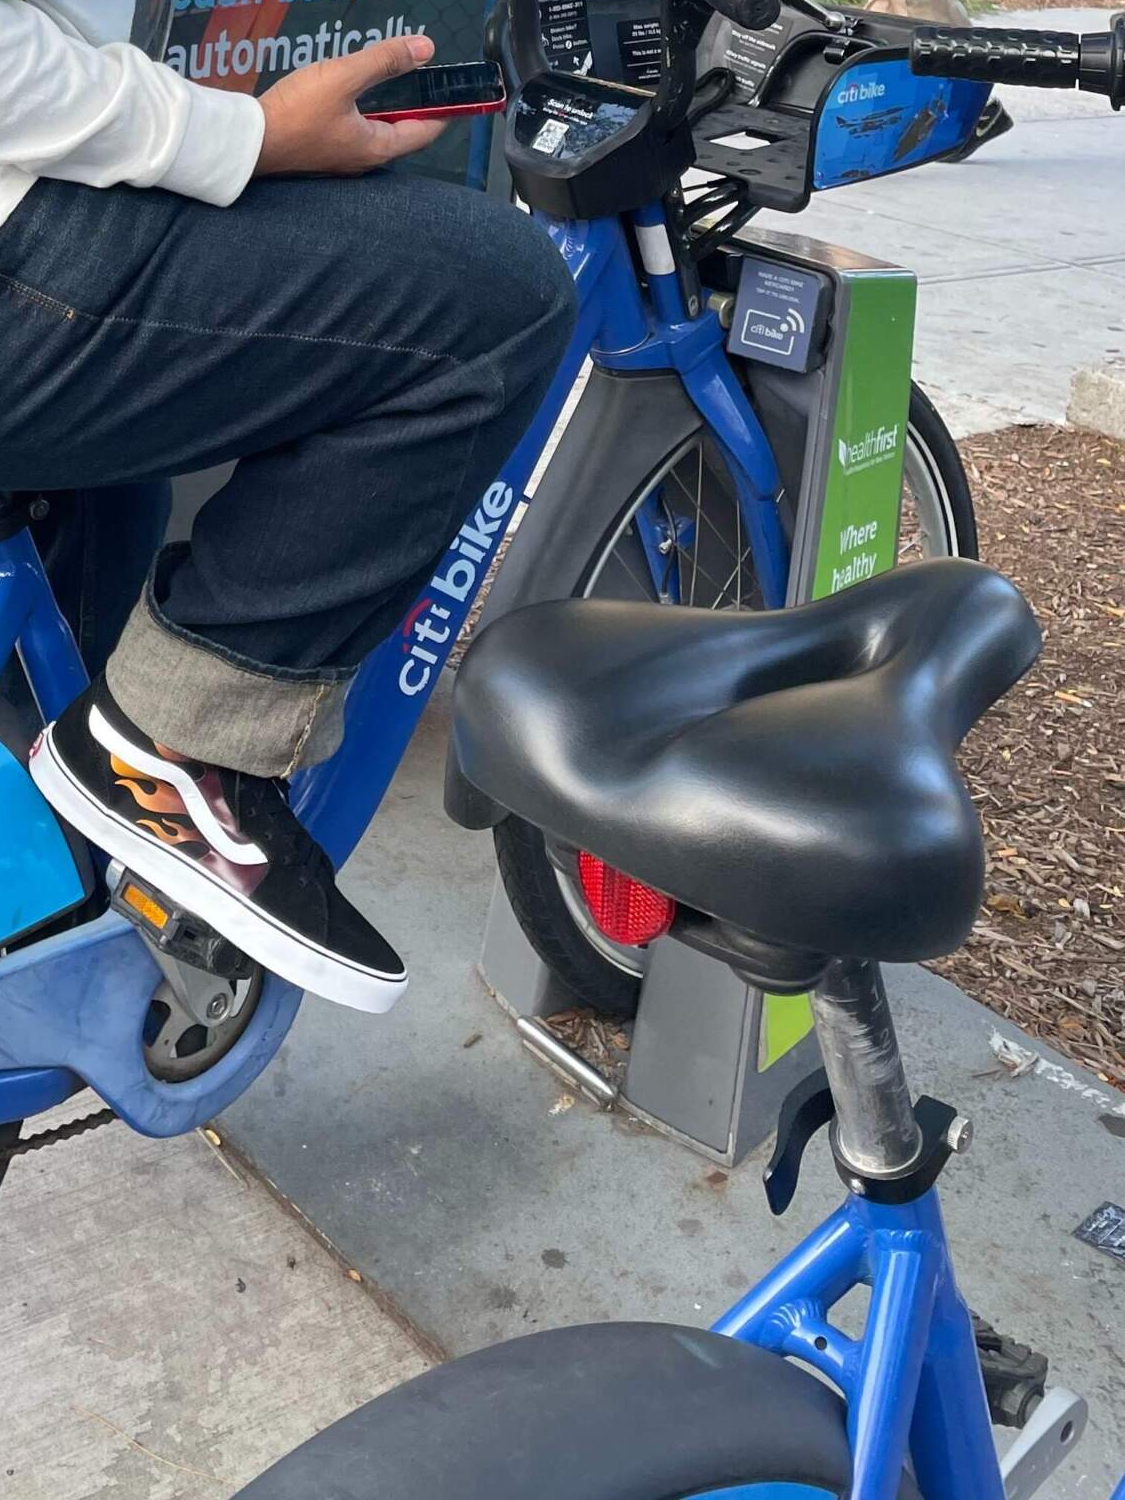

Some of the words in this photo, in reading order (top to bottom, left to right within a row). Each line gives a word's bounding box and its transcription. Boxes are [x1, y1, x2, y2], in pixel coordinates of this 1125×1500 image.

[836, 83, 858, 104] citi
[859, 81, 885, 100] bike
[840, 521, 877, 556] Where
[399, 600, 452, 696] citi
[430, 481, 513, 602] bike
[831, 552, 877, 594] healthy
